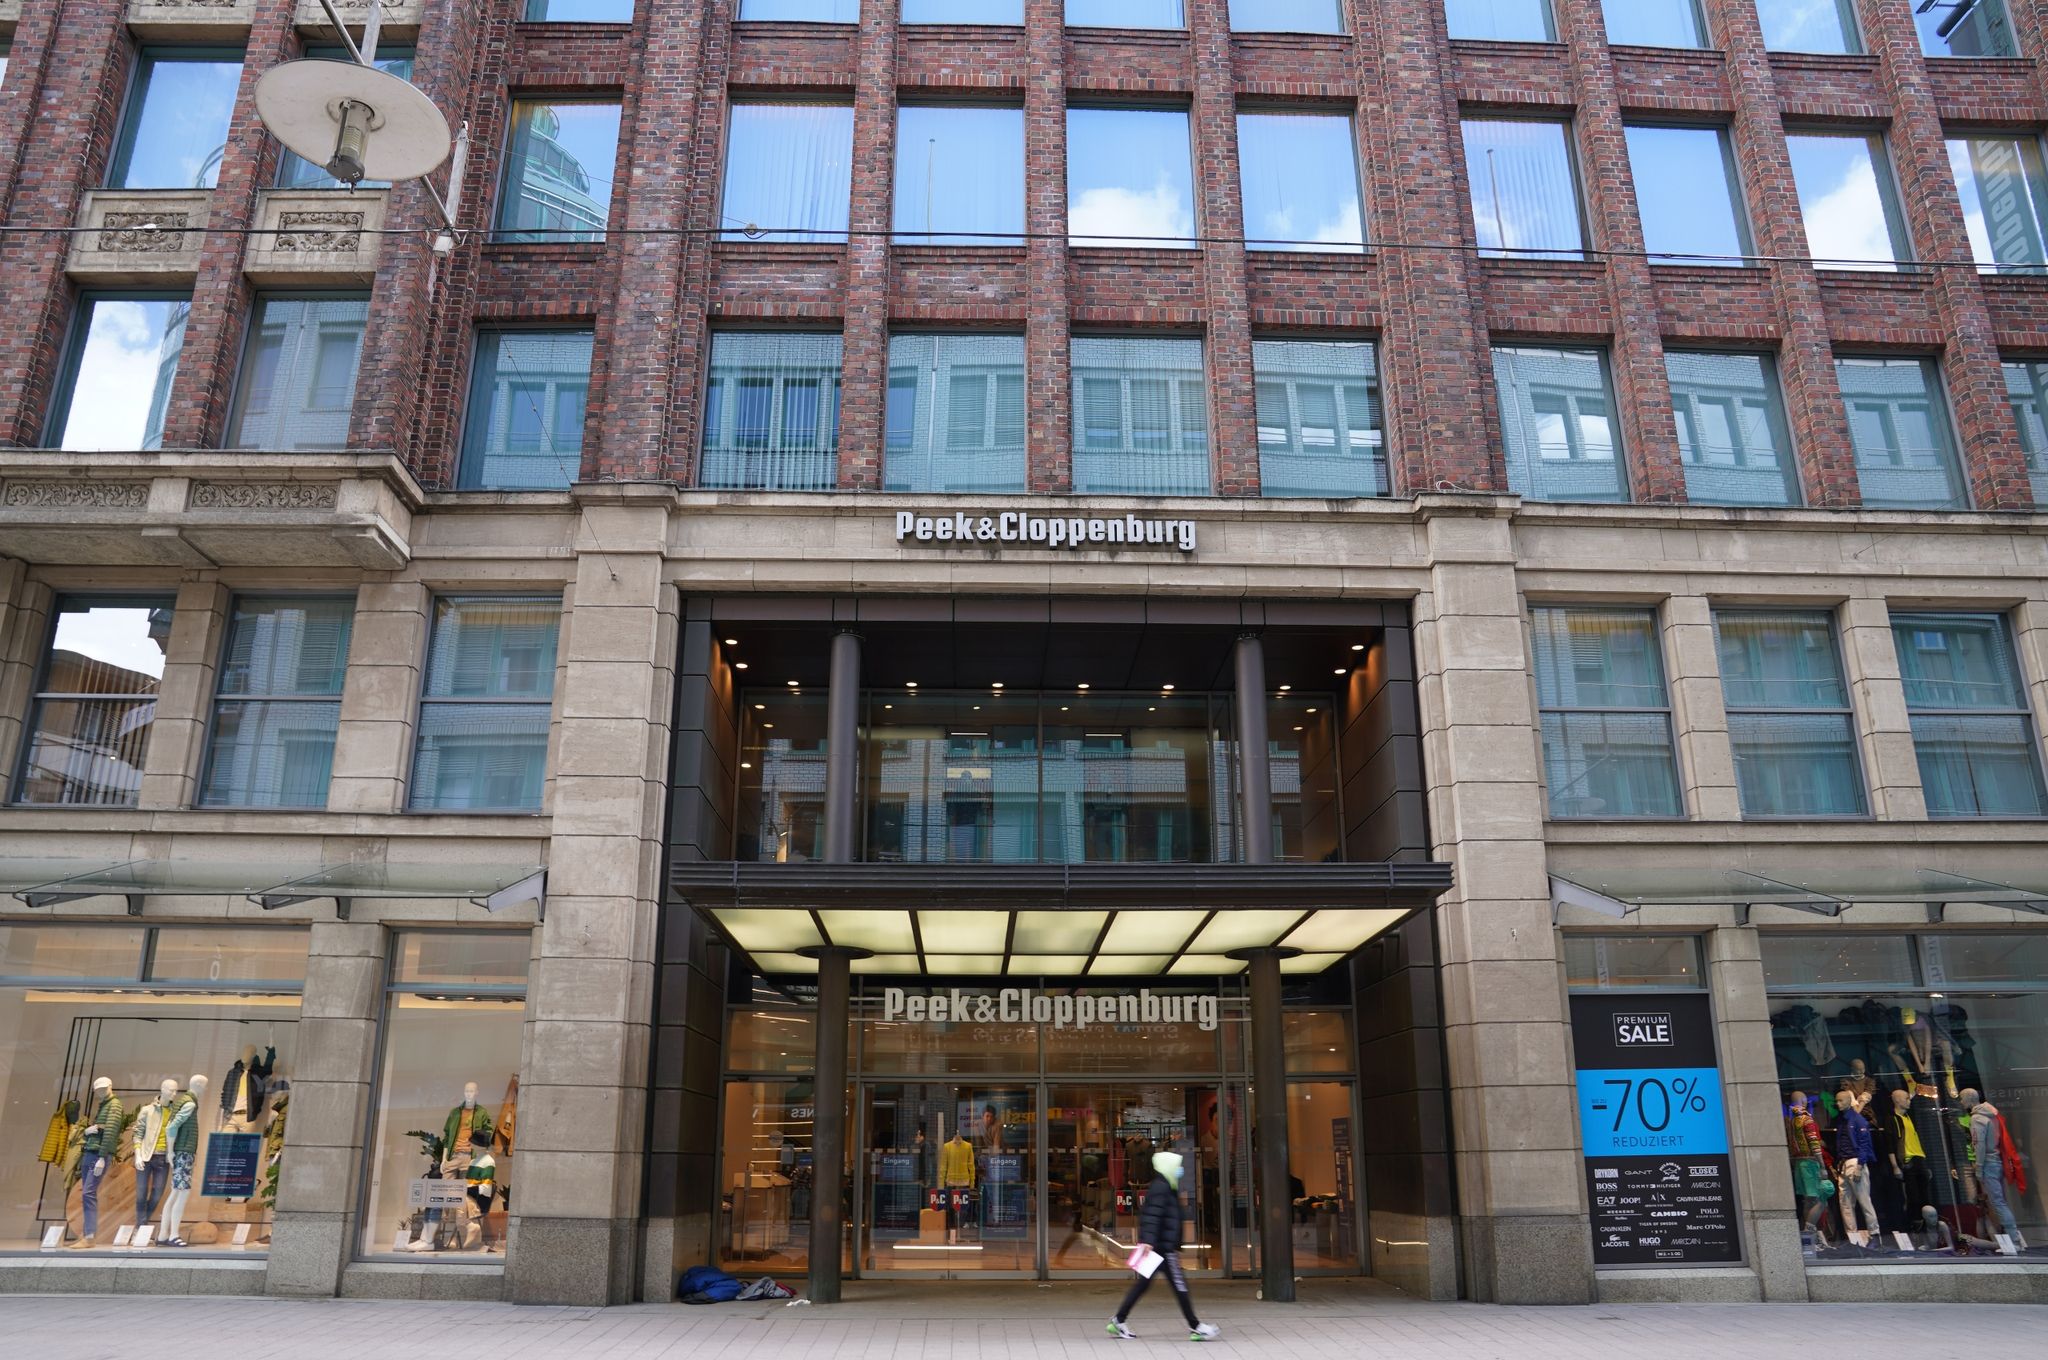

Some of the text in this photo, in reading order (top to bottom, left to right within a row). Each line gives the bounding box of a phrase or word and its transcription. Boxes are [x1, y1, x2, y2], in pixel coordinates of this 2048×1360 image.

[896, 511, 1196, 549] Peek&Cloppenburg
[884, 988, 1217, 1031] Peek&Cloppenburg
[1617, 1016, 1667, 1024] PREMIUM
[1619, 1025, 1669, 1042] SALE
[1592, 1077, 1706, 1132] -70%
[1613, 1136, 1684, 1147] REDUZIERT
[883, 1157, 910, 1165] Eingang
[990, 1157, 1017, 1165] Eingang
[1689, 1167, 1718, 1175] CLOSED
[930, 1194, 946, 1205] P&C
[953, 1194, 969, 1205] P&C
[1117, 1195, 1132, 1206] P&C
[1597, 1196, 1616, 1204] EA7
